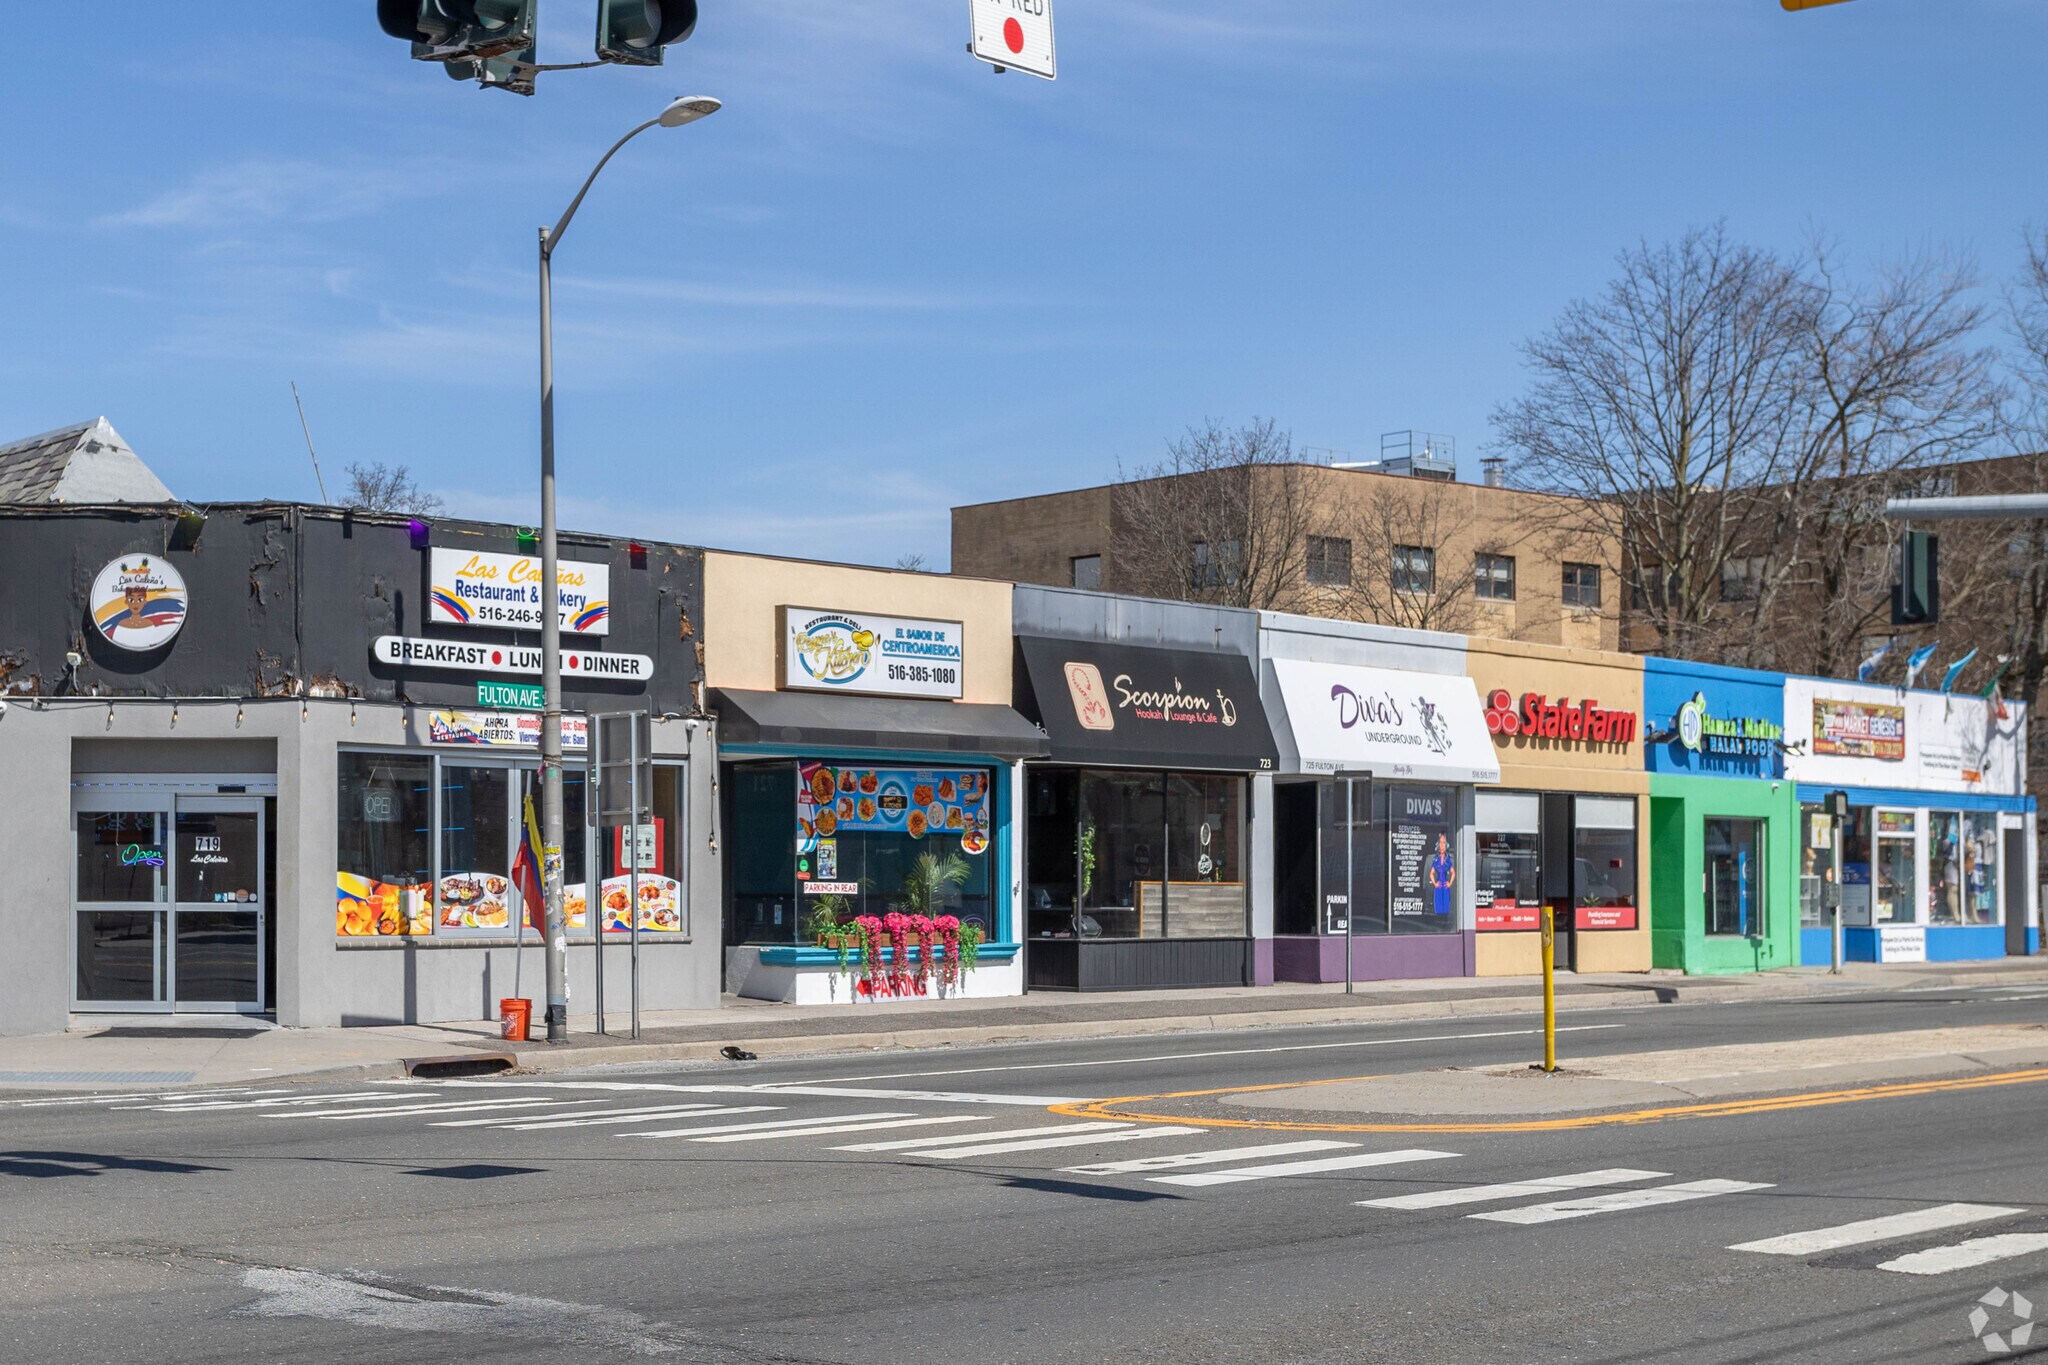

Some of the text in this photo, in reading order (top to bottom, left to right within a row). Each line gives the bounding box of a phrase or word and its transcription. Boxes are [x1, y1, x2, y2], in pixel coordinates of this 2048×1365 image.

[456, 555, 586, 587] Las Calñas
[118, 575, 133, 586] Las
[455, 579, 526, 603] Restaurant
[530, 586, 539, 603] &
[479, 606, 566, 627] 516-246-97
[804, 615, 843, 630] RESTAURANT
[849, 619, 862, 631] DELI
[895, 628, 945, 643] EL SABOR DE
[390, 641, 640, 675] BREAKFAST LUN DINNER
[882, 640, 960, 658] CENTROAMERICA
[888, 664, 955, 685] 516-385-1080
[478, 685, 542, 708] FULTON AVE.
[1113, 674, 1210, 722] Scorpion
[1331, 684, 1403, 729] Diva's
[1135, 708, 1218, 725] Hookah Lounge & Cafe
[1702, 713, 1737, 737] Hamza
[479, 728, 516, 741] ABIERTOS:
[1870, 716, 1896, 737] GENESIS
[1365, 731, 1422, 746] UNDERGROUND
[1709, 736, 1774, 756] HALAL FOOD
[1260, 758, 1272, 769] 723
[1305, 761, 1345, 771] 725 FULTON AVE
[1406, 798, 1442, 816] DIVA'S
[197, 837, 219, 851] 719
[121, 843, 163, 866] Open
[804, 883, 857, 893] PARKING IN REAR
[1326, 895, 1347, 904] PARKIN
[1337, 919, 1347, 929] REA
[872, 974, 928, 999] PARKING
